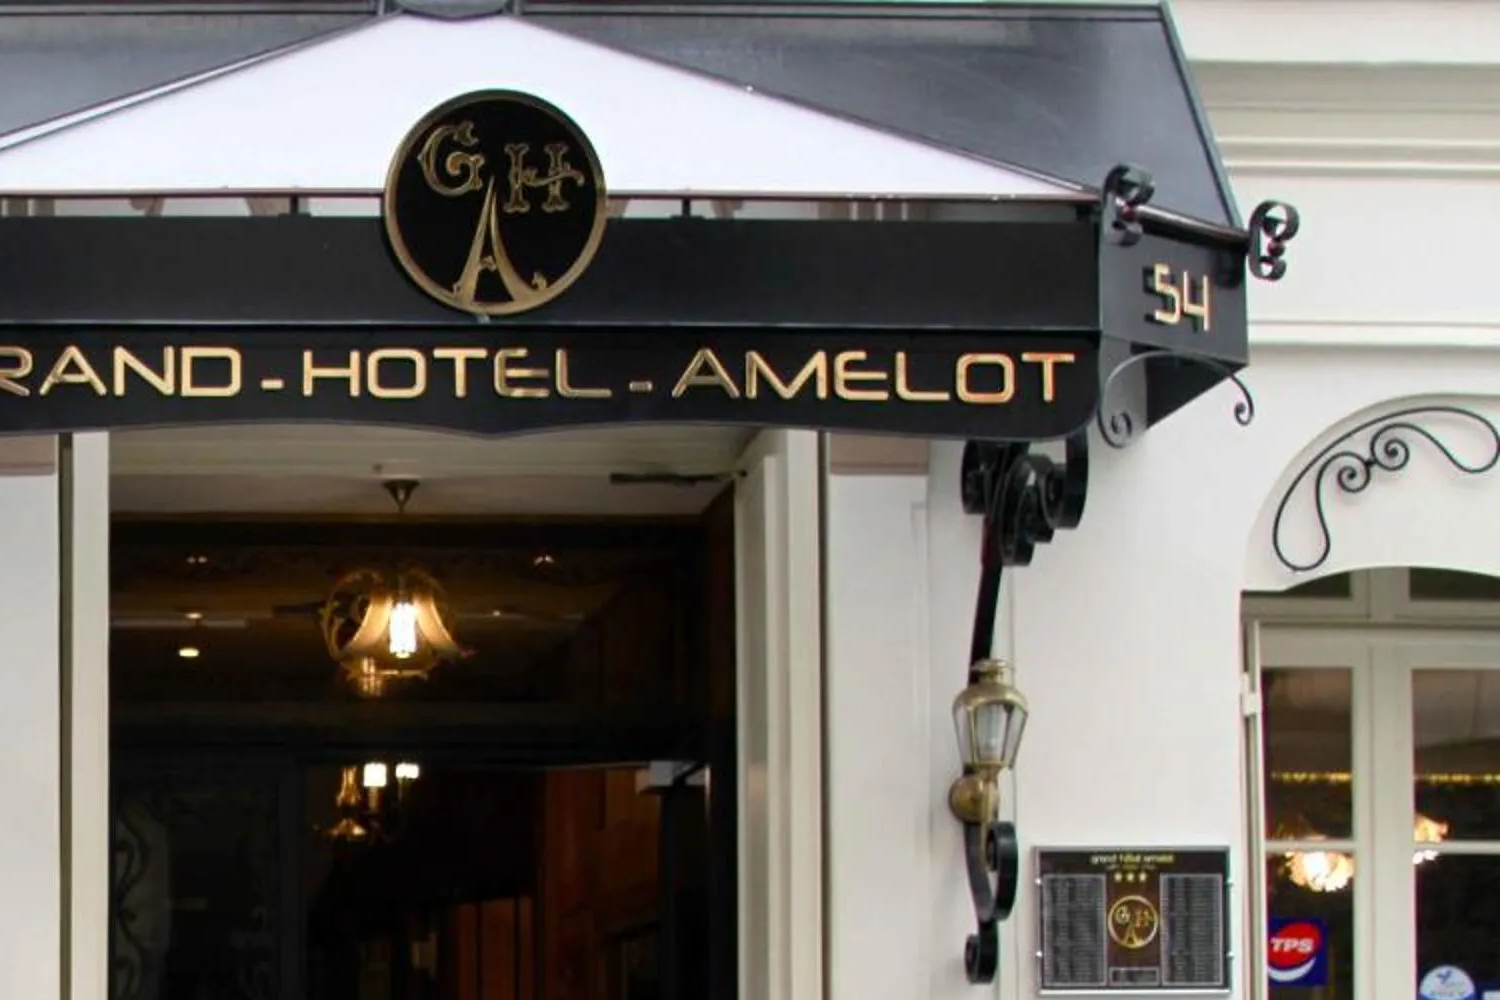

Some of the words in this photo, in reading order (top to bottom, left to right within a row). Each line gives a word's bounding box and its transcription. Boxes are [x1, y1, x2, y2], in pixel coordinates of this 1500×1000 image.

[1153, 262, 1210, 332] 54
[301, 347, 613, 399] HOTEL
[671, 347, 1076, 404] AMELOT
[1270, 937, 1315, 953] TPS
